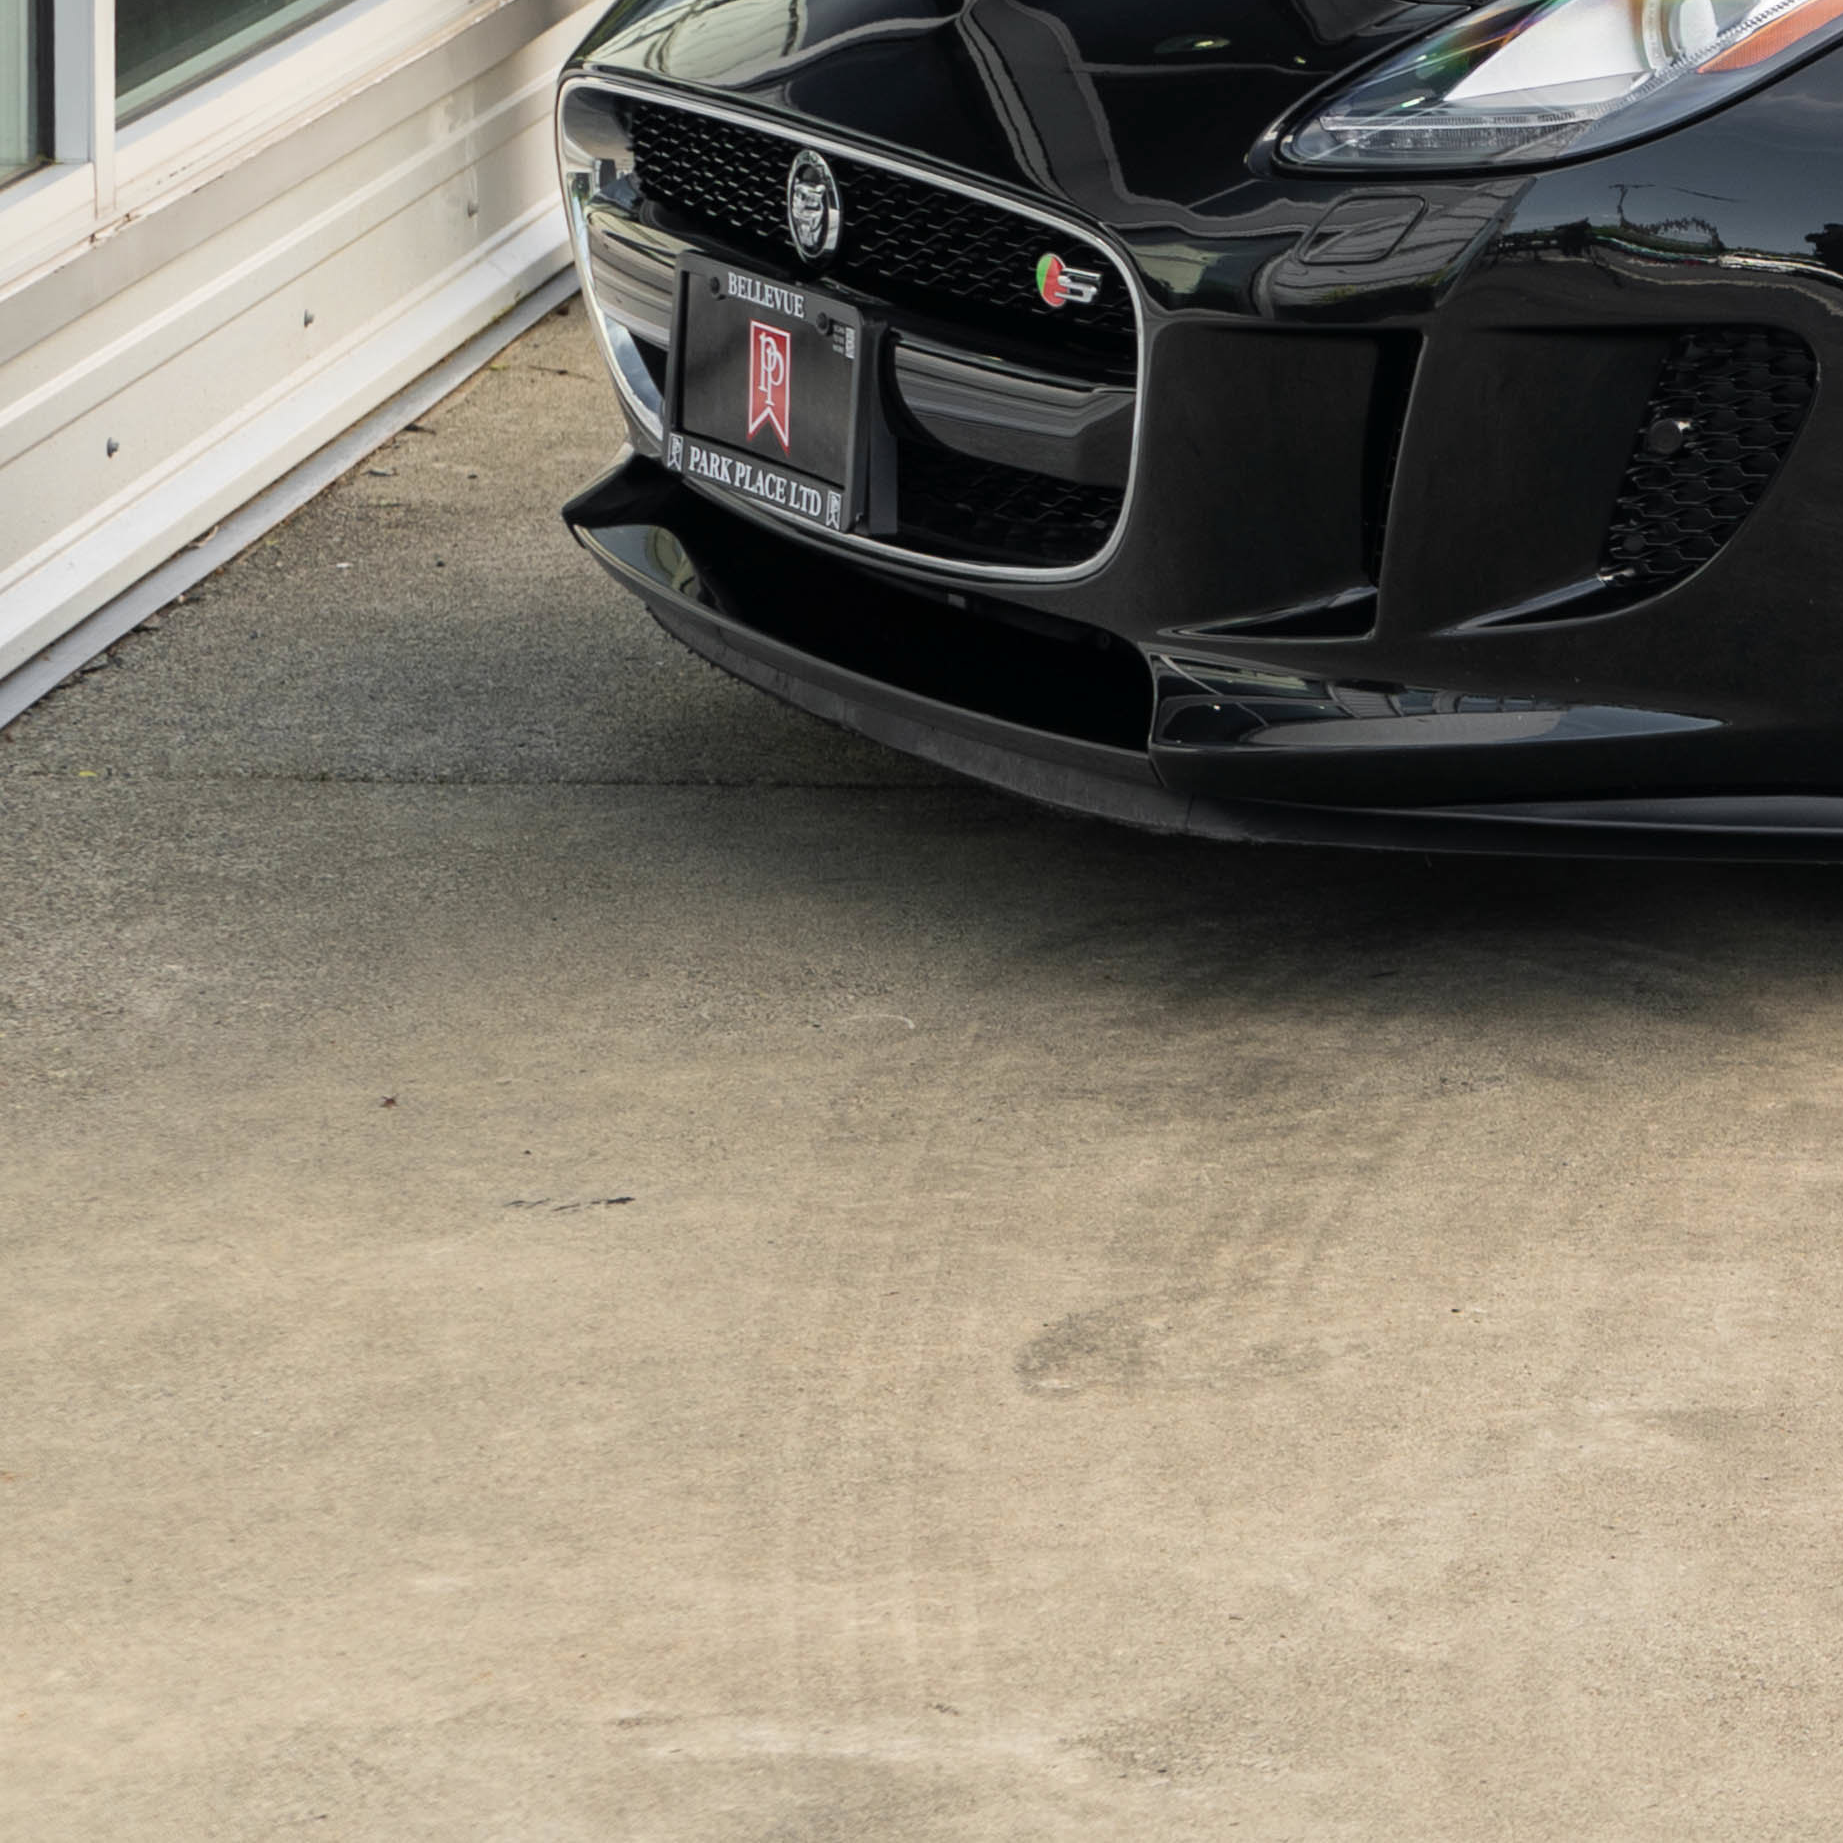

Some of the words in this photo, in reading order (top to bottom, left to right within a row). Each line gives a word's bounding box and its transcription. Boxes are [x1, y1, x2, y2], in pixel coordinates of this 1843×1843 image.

[727, 271, 805, 319] BELLEVUE
[688, 445, 732, 485] PARK
[733, 461, 787, 505] PLACE
[789, 481, 822, 517] LTD
